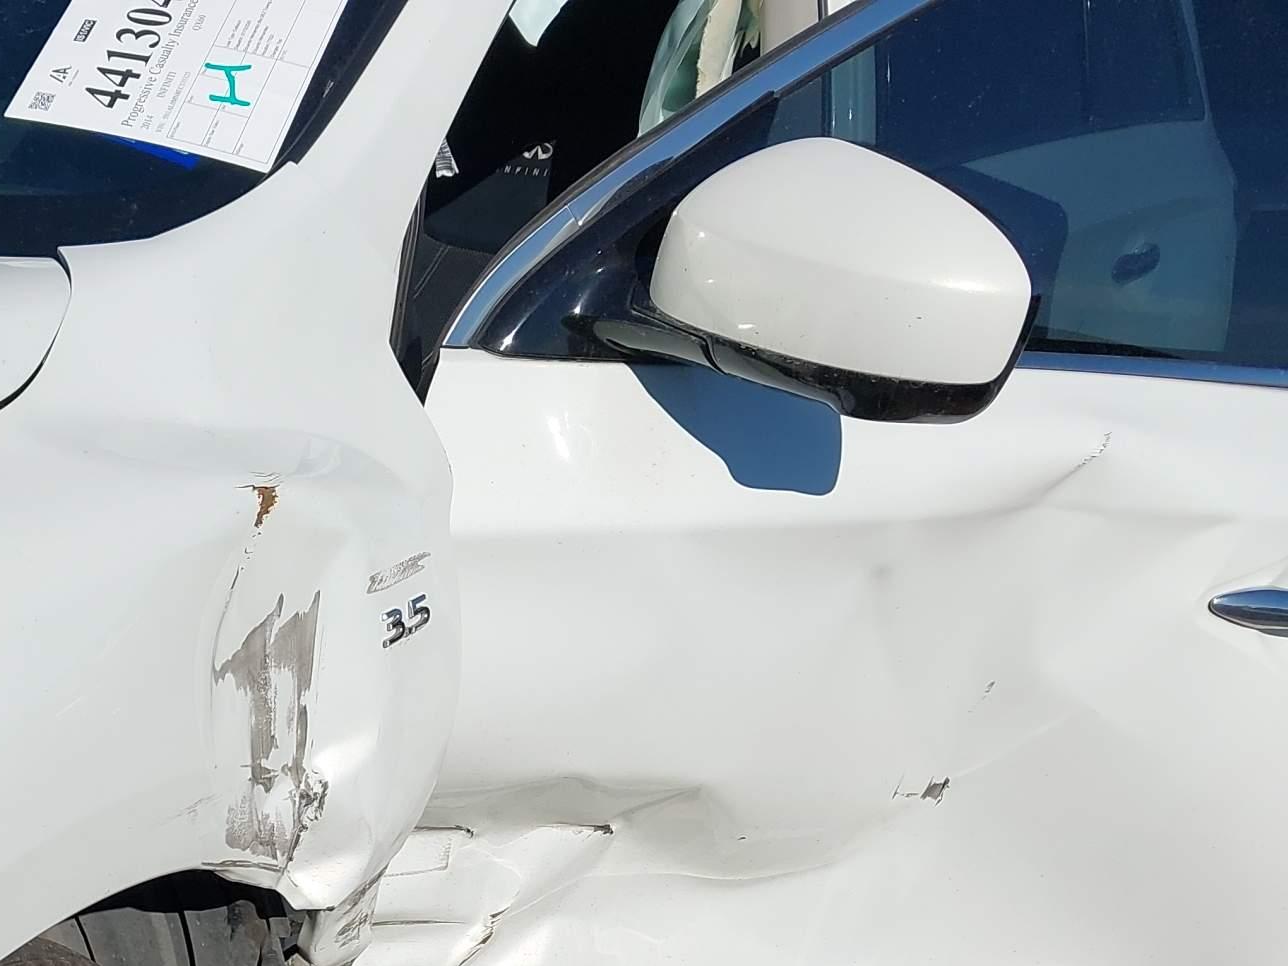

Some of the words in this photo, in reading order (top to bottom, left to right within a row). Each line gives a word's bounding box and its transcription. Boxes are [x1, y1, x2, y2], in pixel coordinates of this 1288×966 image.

[120, 76, 157, 127] Progressive
[149, 37, 180, 75] Casualty
[204, 62, 252, 107] H
